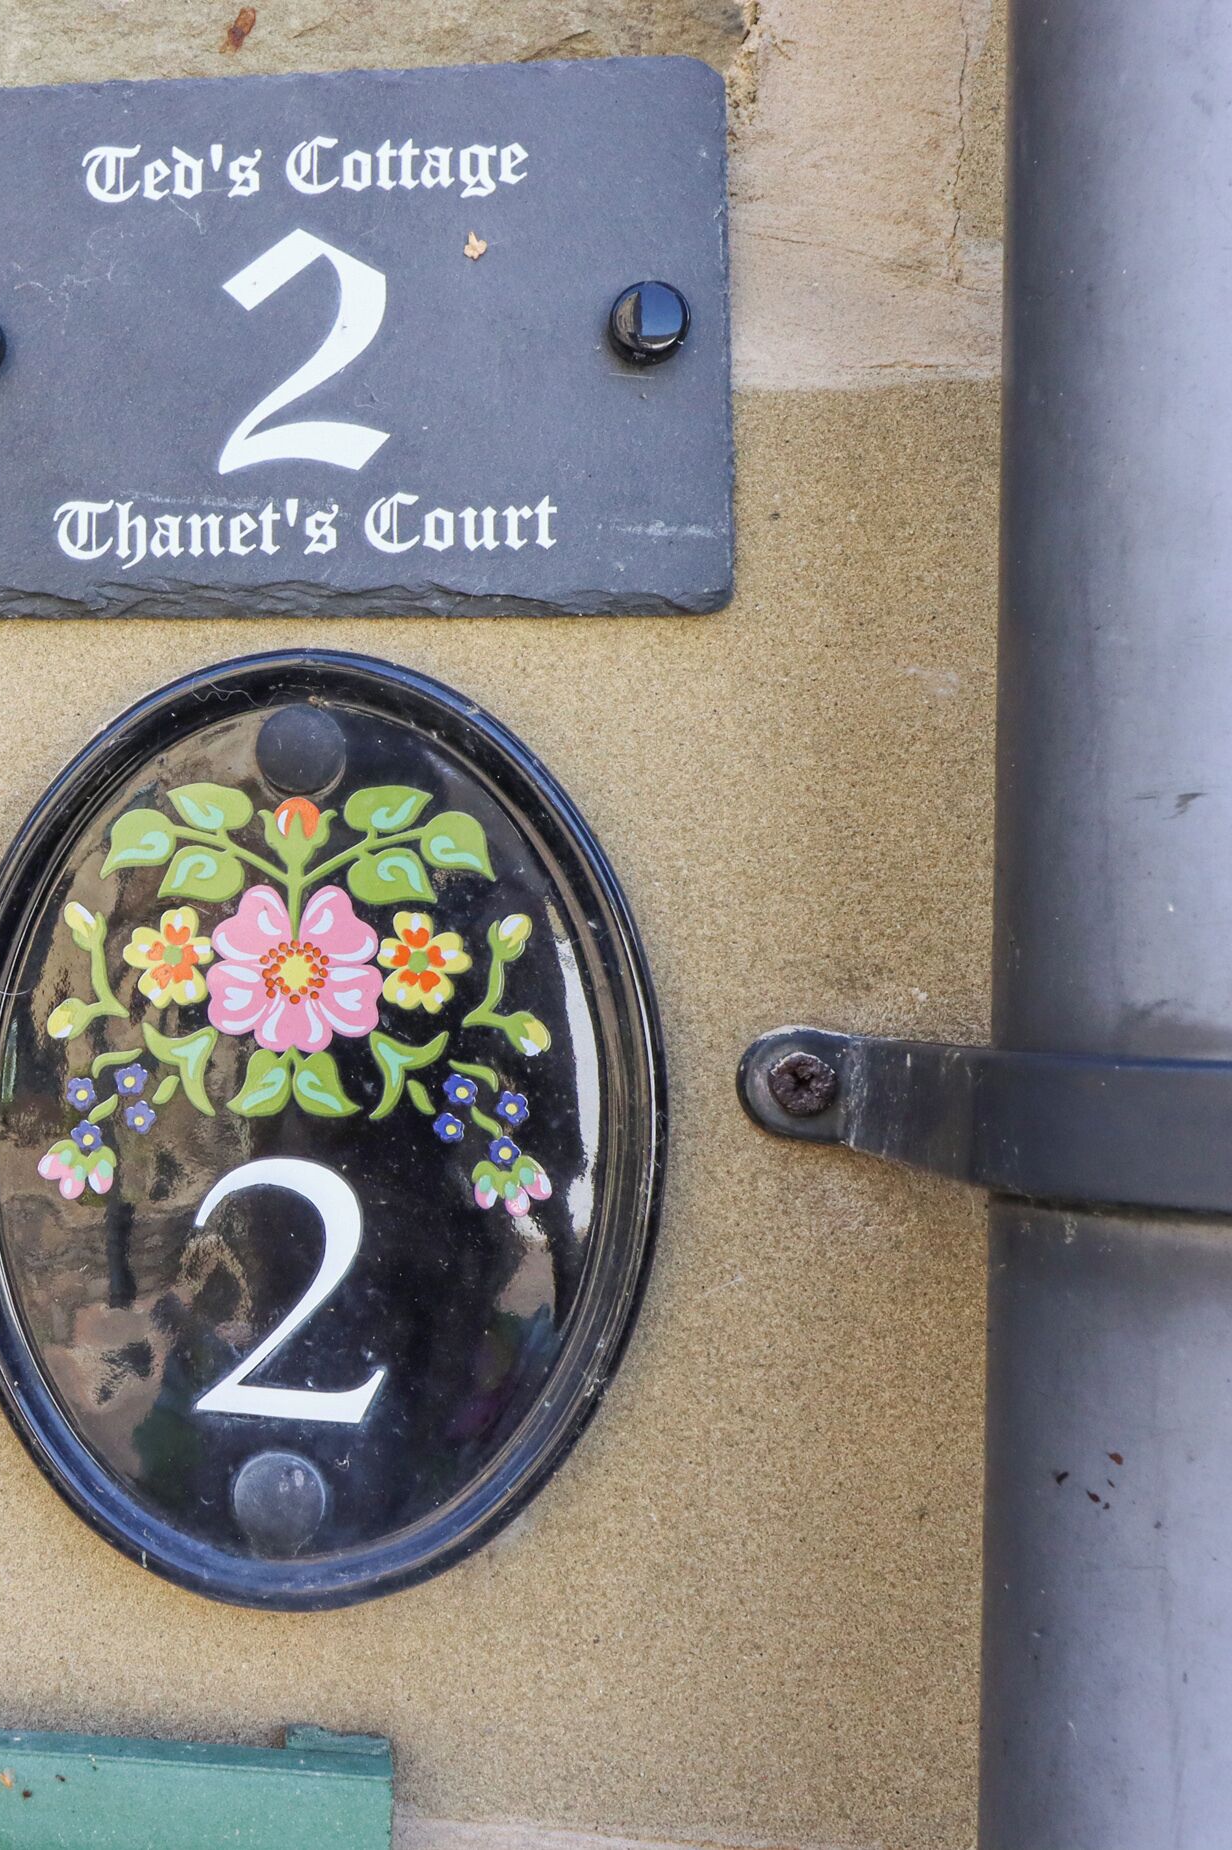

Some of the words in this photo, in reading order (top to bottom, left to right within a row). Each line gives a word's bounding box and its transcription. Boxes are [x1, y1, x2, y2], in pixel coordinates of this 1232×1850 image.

[80, 143, 262, 204] Ted's
[284, 135, 530, 200] Cottage
[217, 227, 392, 476] 2
[52, 498, 340, 571] Thanet's
[363, 491, 559, 555] Court
[192, 1156, 386, 1425] 2
